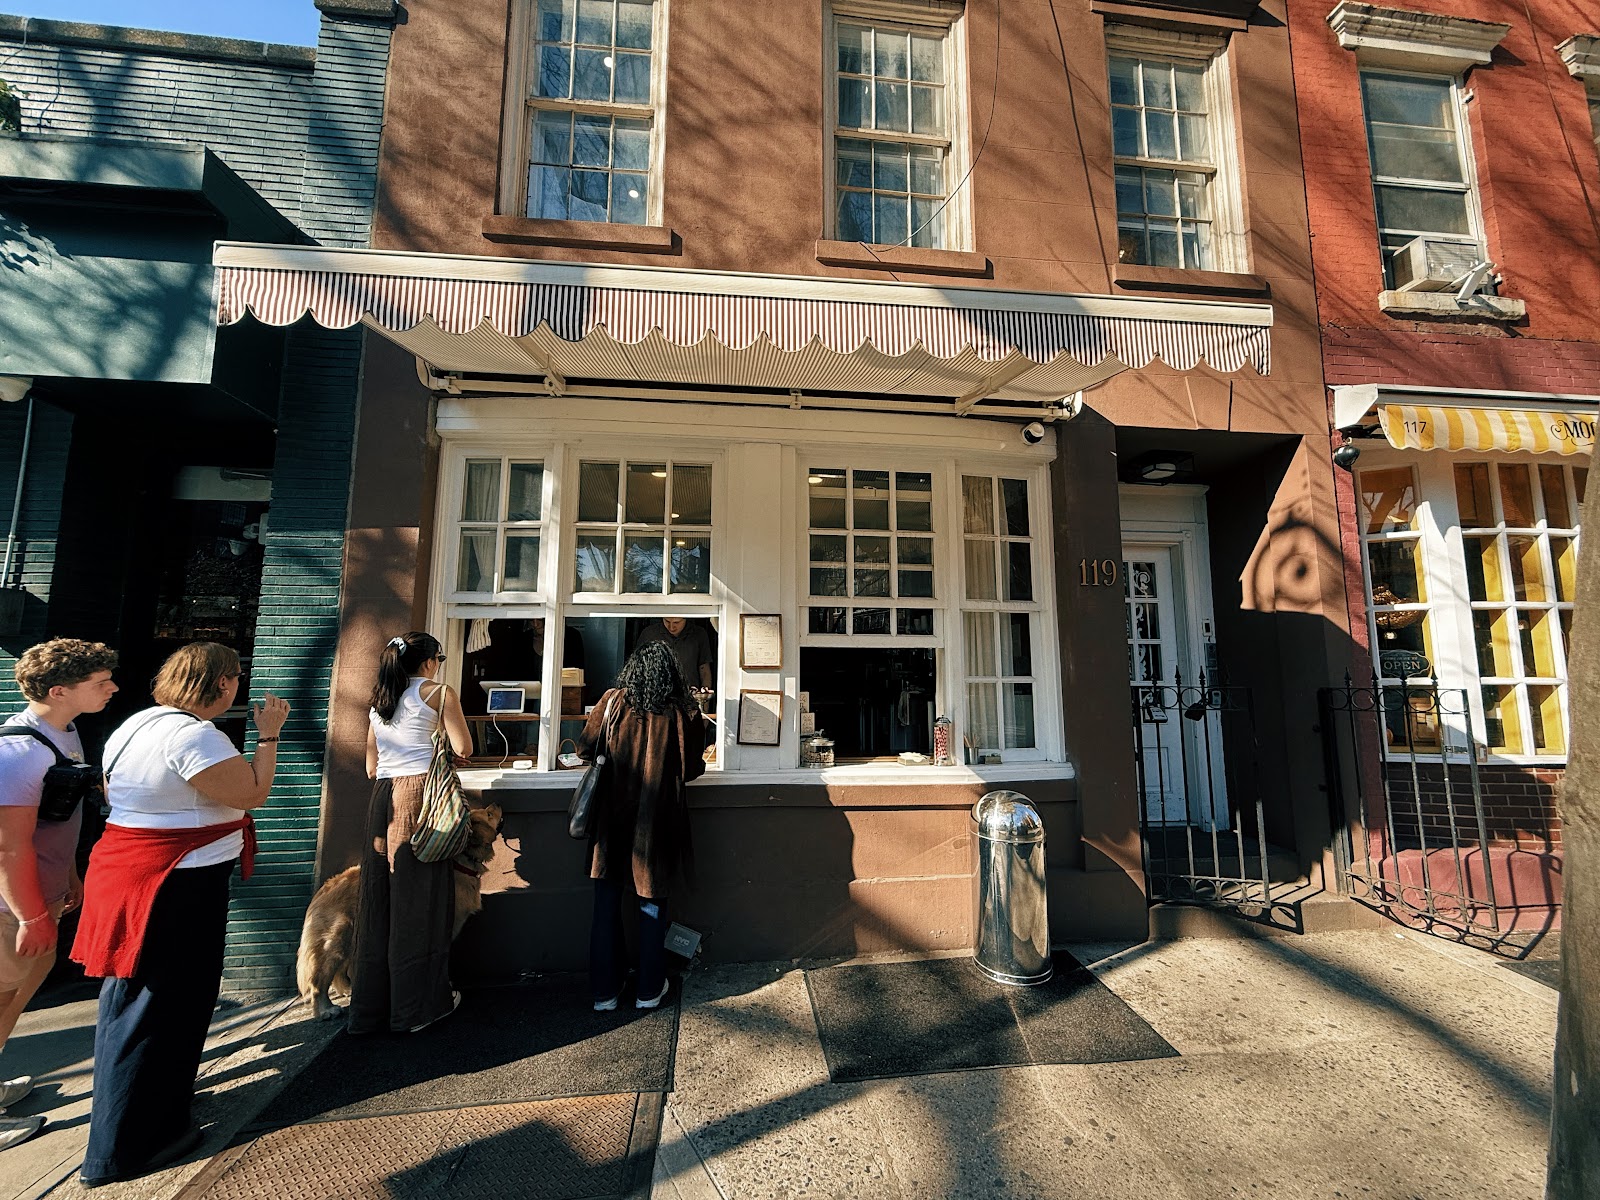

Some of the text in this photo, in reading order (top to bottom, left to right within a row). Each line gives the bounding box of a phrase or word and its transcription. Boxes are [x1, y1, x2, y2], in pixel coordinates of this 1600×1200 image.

[1404, 421, 1426, 433] 117
[1079, 559, 1117, 586] 119
[1384, 661, 1420, 670] OPEN
